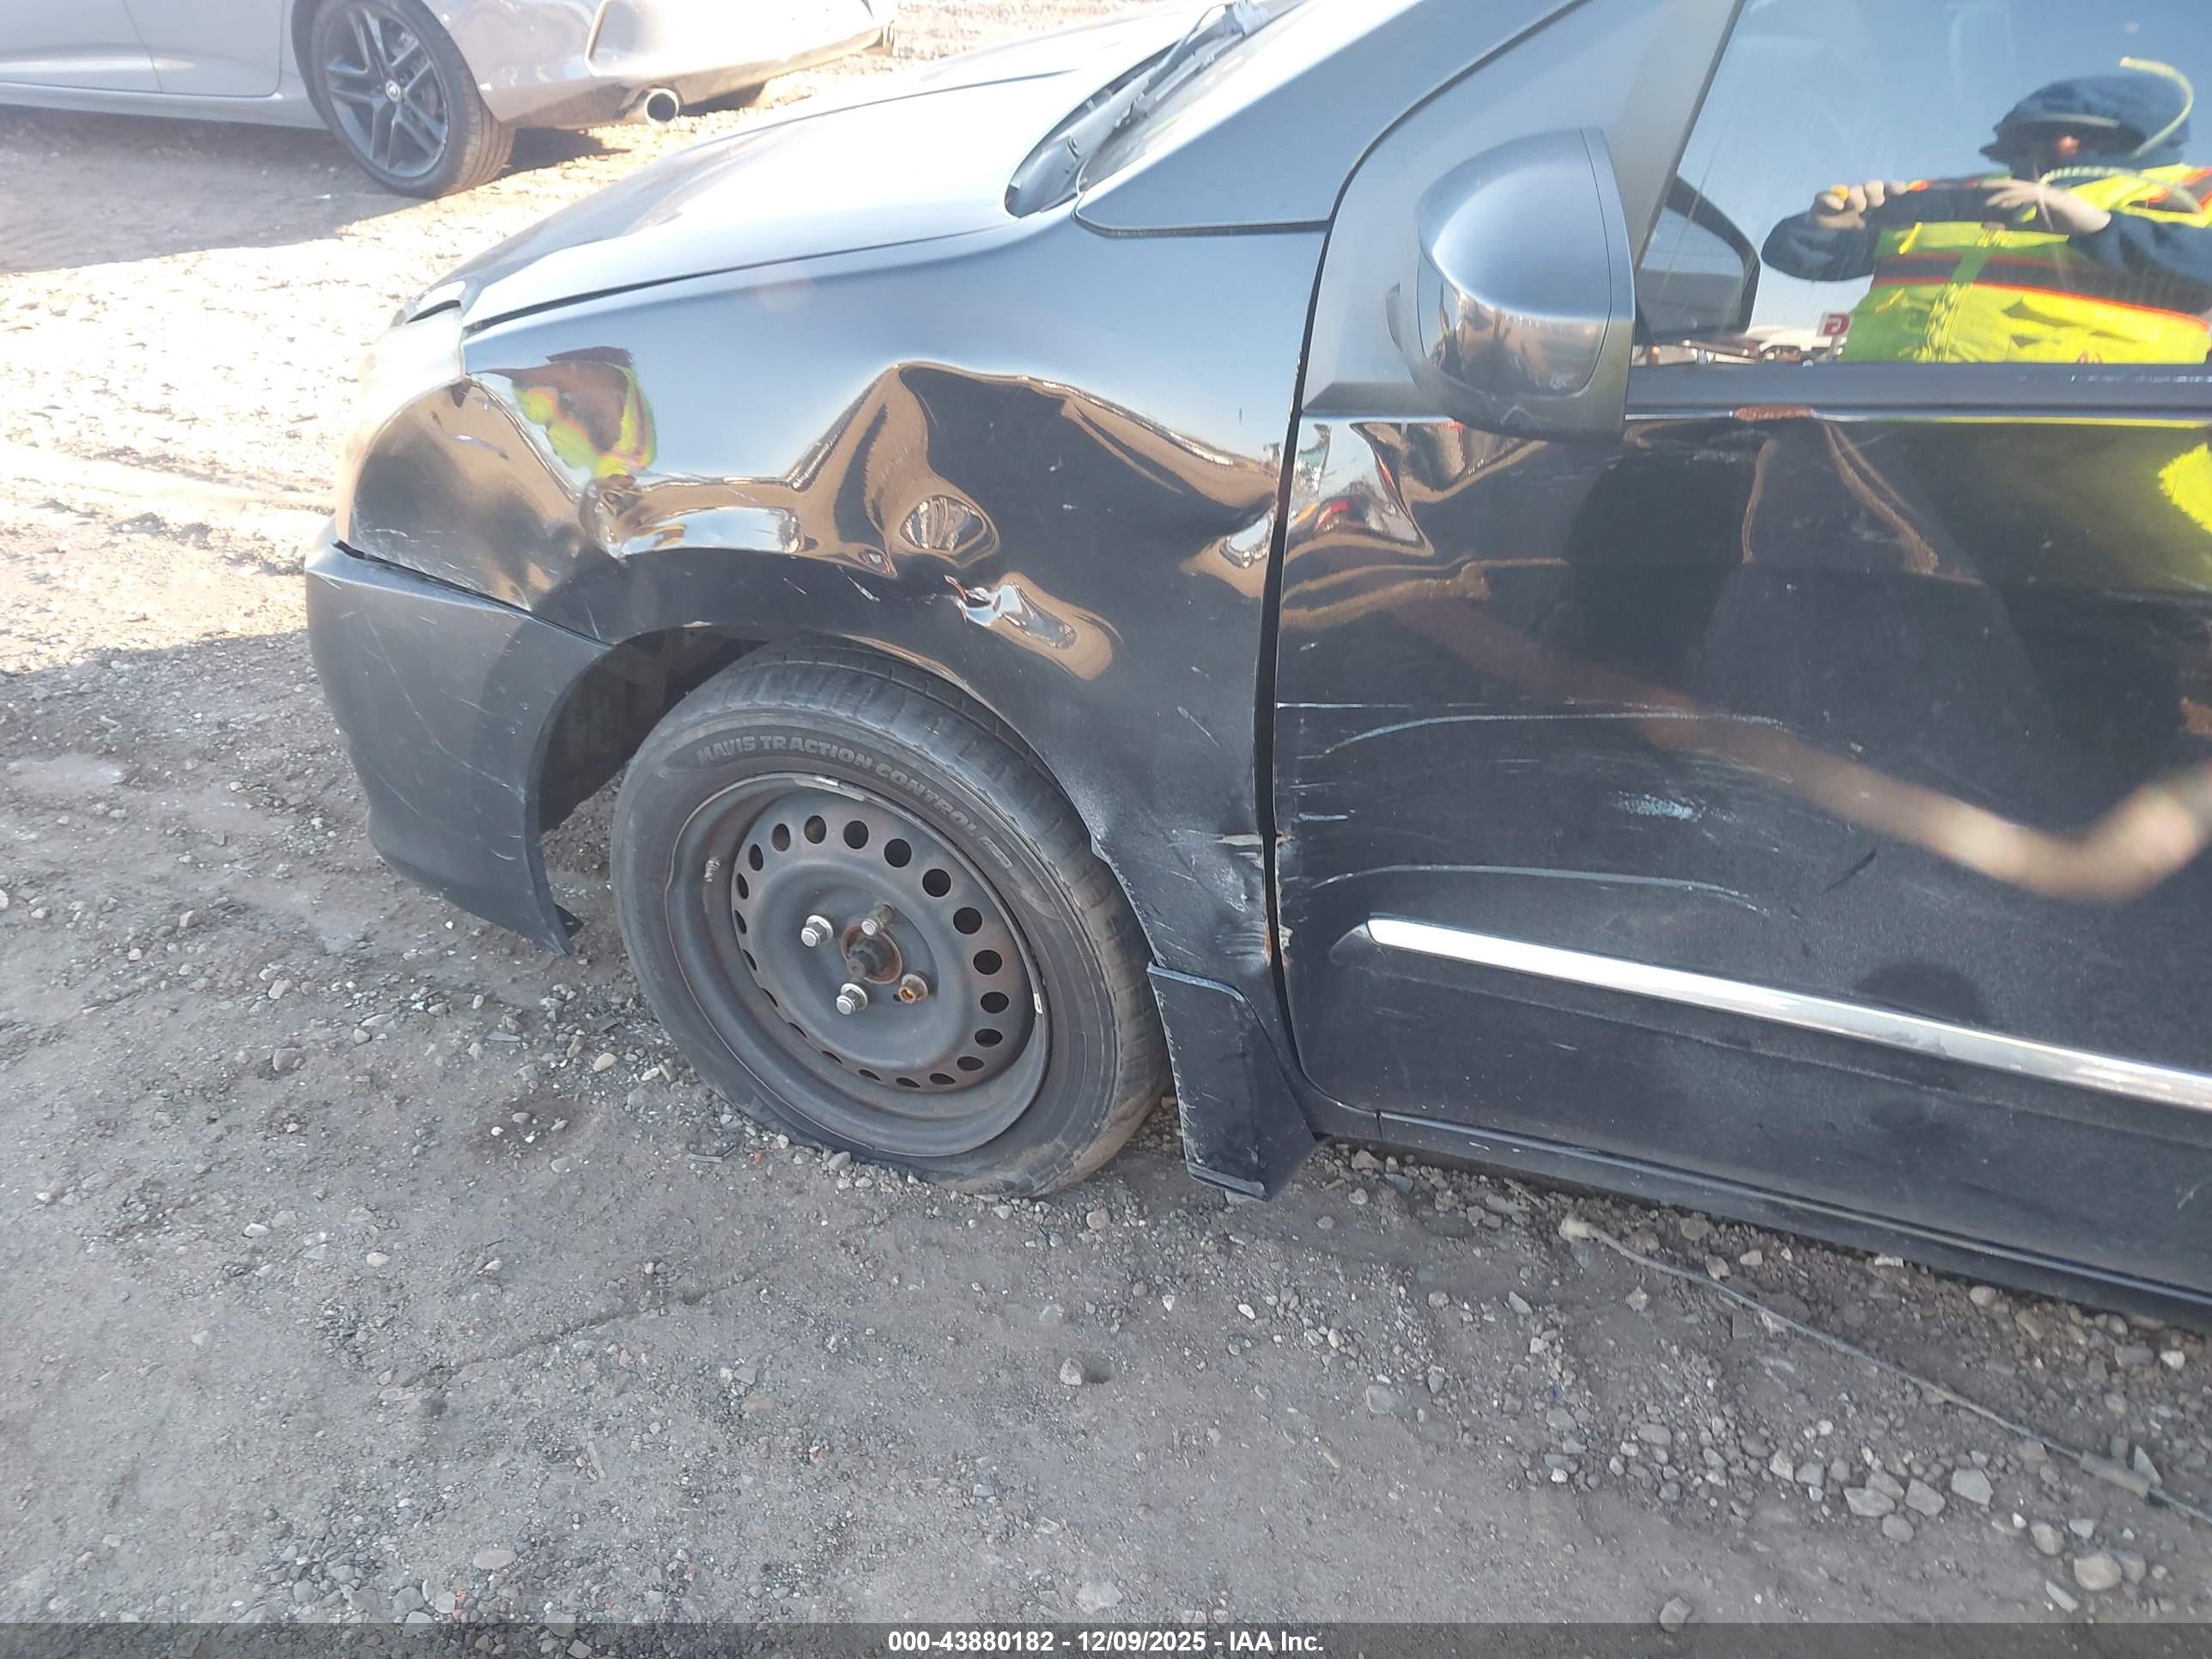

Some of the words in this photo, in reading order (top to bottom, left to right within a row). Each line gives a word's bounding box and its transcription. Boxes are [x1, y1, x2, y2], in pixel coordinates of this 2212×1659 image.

[696, 735, 757, 766] MAVIS
[760, 735, 873, 770] TRACTION
[876, 763, 977, 837] CONTROL
